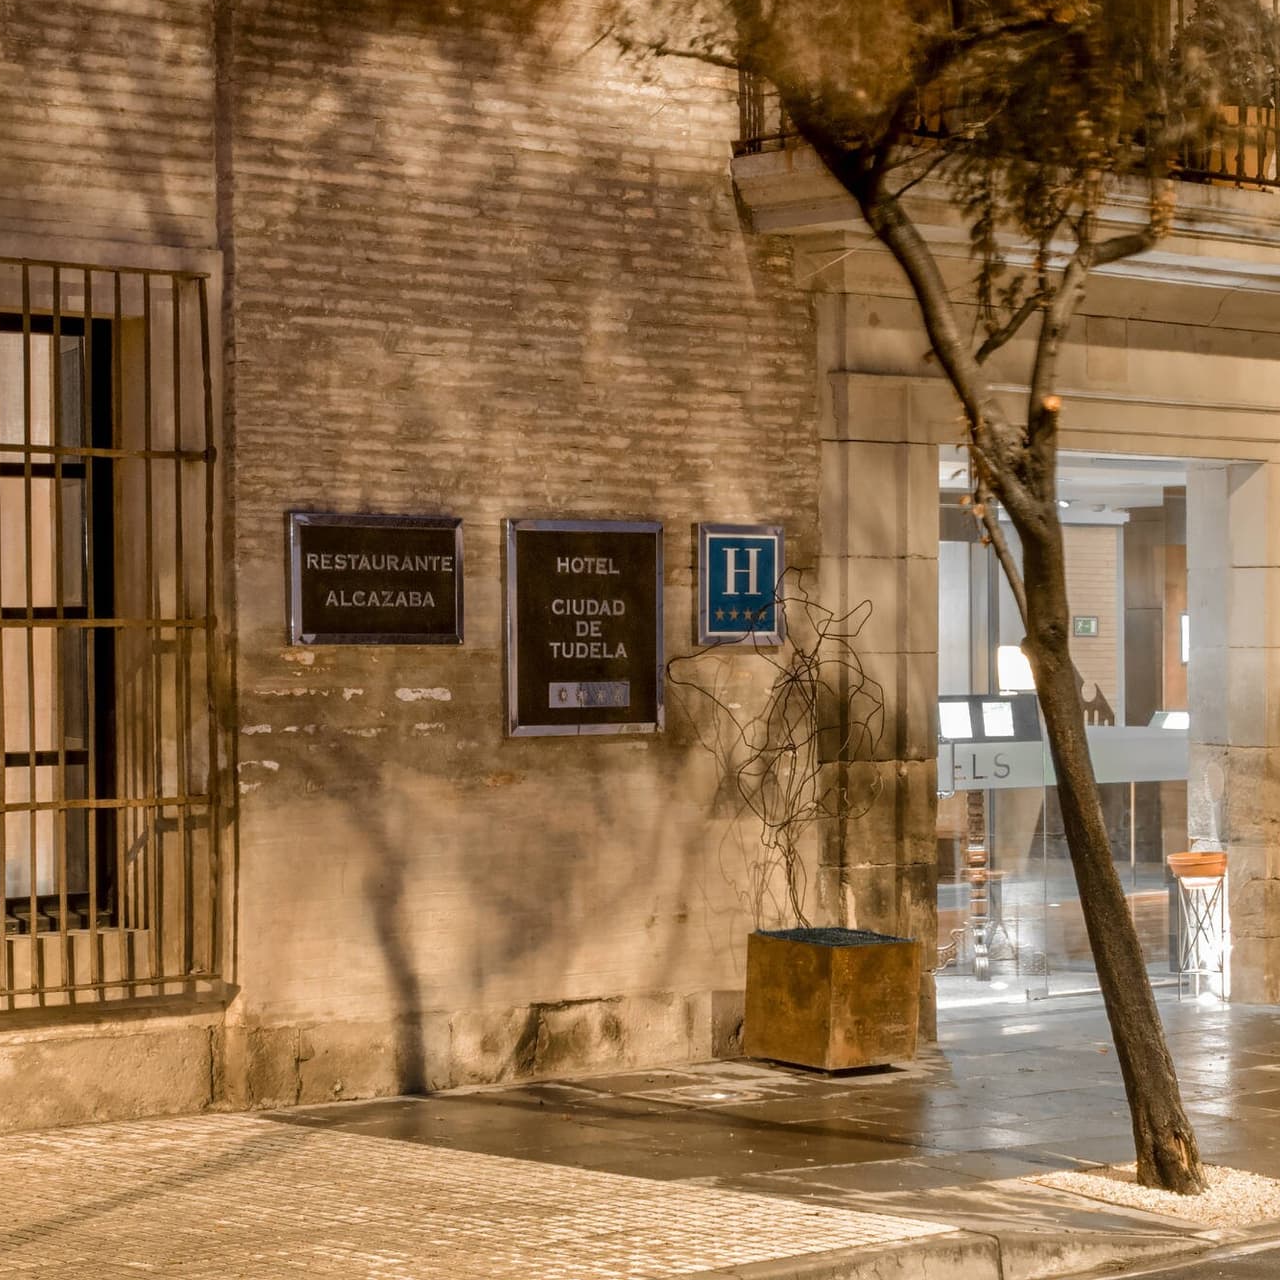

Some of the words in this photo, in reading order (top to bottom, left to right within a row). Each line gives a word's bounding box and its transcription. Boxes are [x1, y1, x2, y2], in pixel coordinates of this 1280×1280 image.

[306, 553, 453, 572] RESTAURANTE
[556, 556, 620, 575] HOTEL
[721, 547, 762, 595] H
[325, 590, 436, 608] ALCAZABA
[551, 598, 626, 616] CIUDAD
[576, 620, 602, 637] DE
[549, 642, 628, 659] TUDELA
